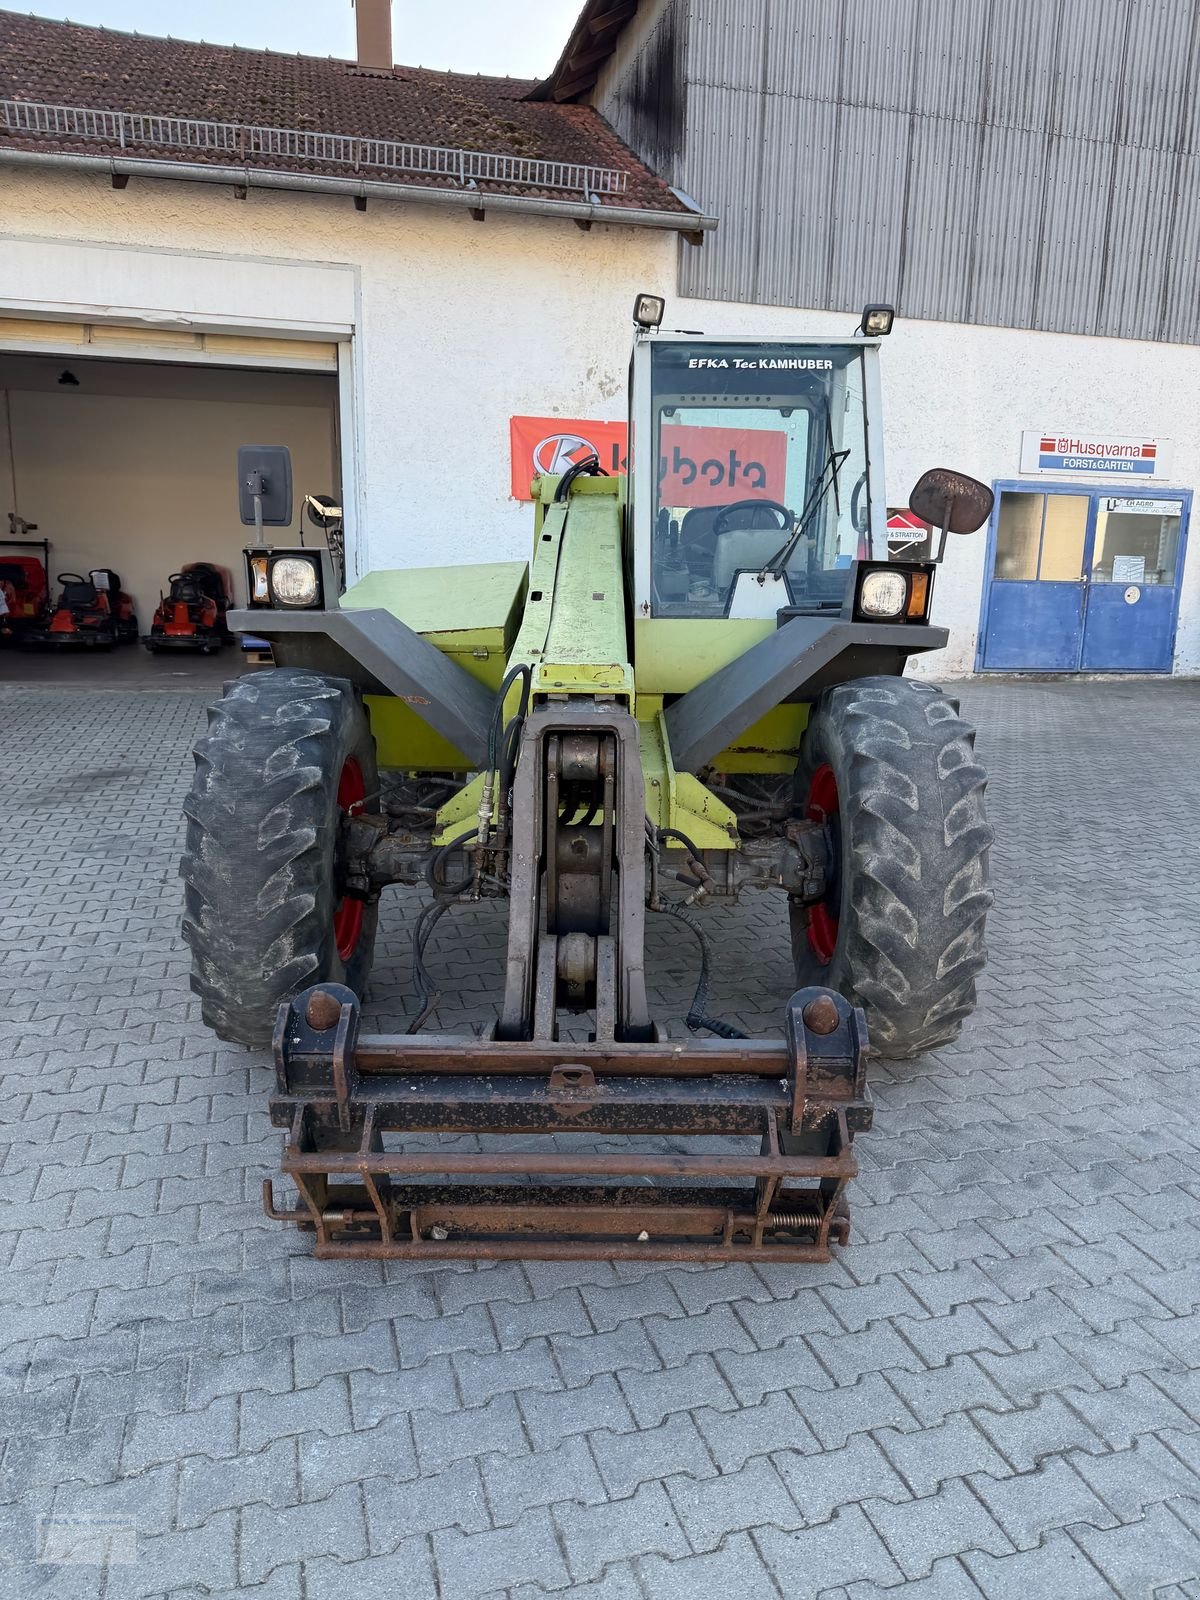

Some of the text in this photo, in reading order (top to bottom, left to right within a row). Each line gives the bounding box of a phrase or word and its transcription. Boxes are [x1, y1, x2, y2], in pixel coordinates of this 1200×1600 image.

[688, 358, 833, 370] EFKA Tec KAMHUBER
[1069, 439, 1141, 457] Husqvarna
[1063, 458, 1134, 471] FORST&GARTEN
